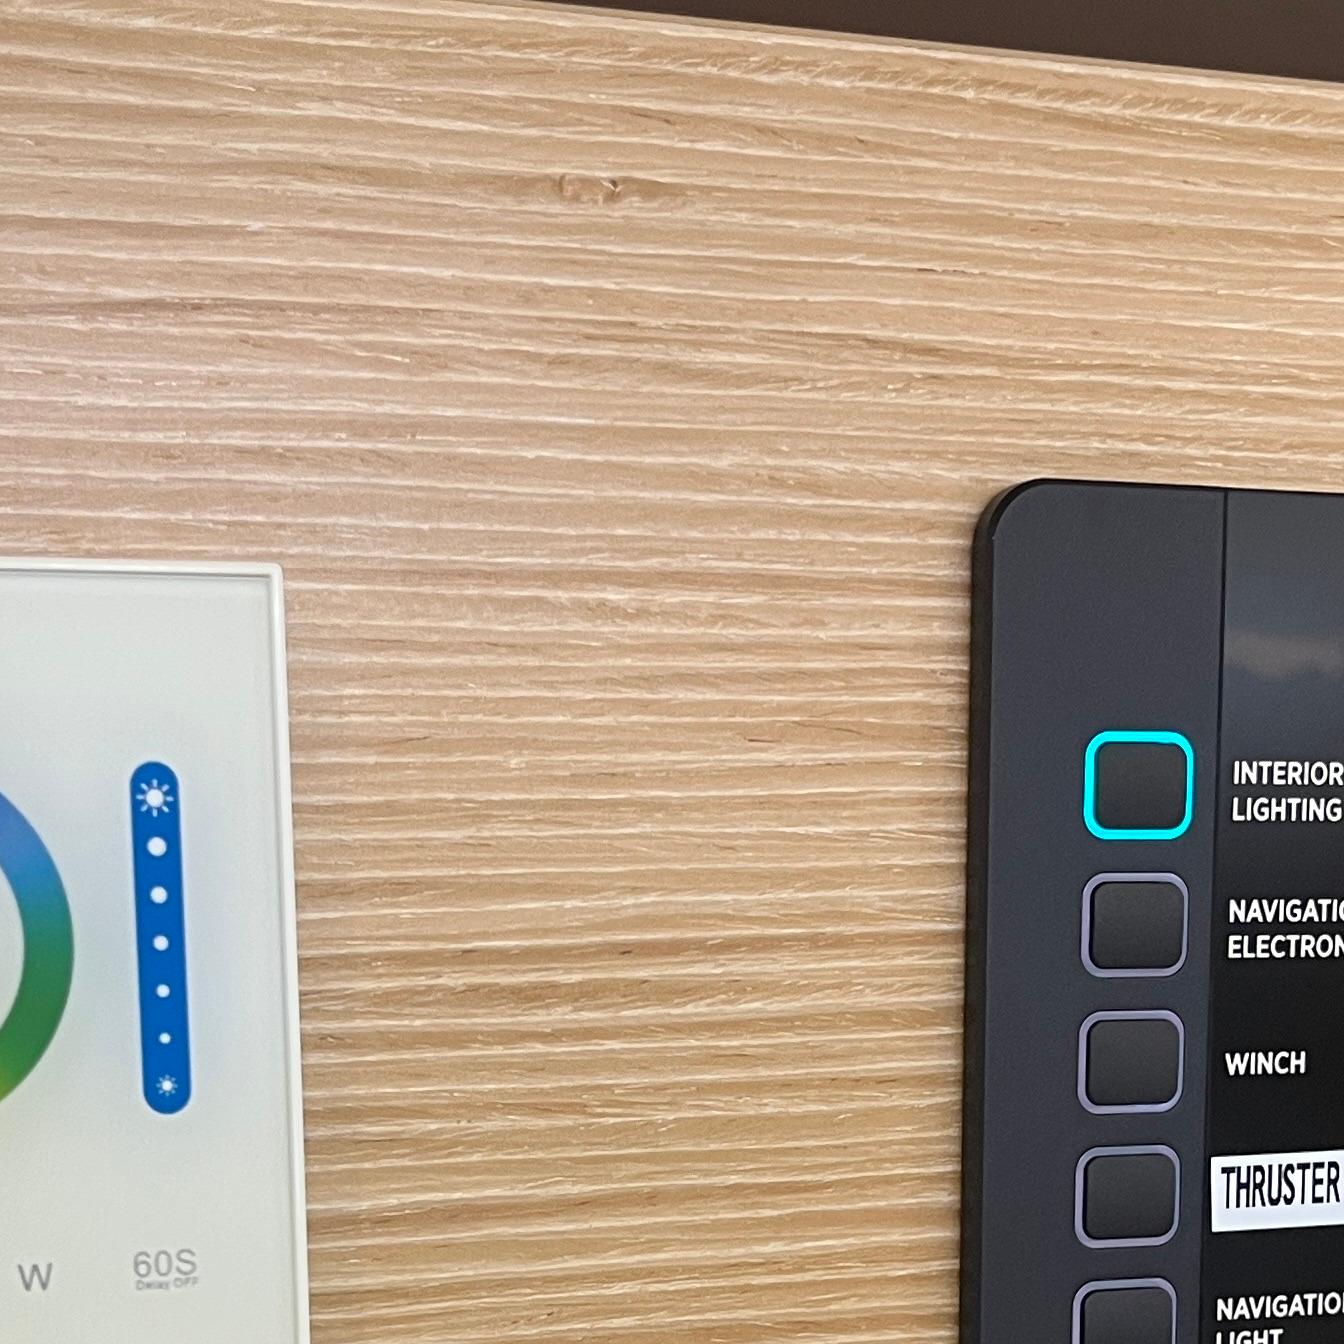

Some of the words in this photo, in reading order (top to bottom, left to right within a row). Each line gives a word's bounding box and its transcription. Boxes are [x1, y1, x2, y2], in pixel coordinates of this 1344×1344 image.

[1233, 760, 1344, 786] INTERIOR
[1232, 796, 1343, 822] LIGHTING
[1224, 1050, 1306, 1076] WINCH
[1221, 1161, 1340, 1209] THRUSTER
[17, 1262, 53, 1292] W
[133, 1248, 196, 1278] 60S
